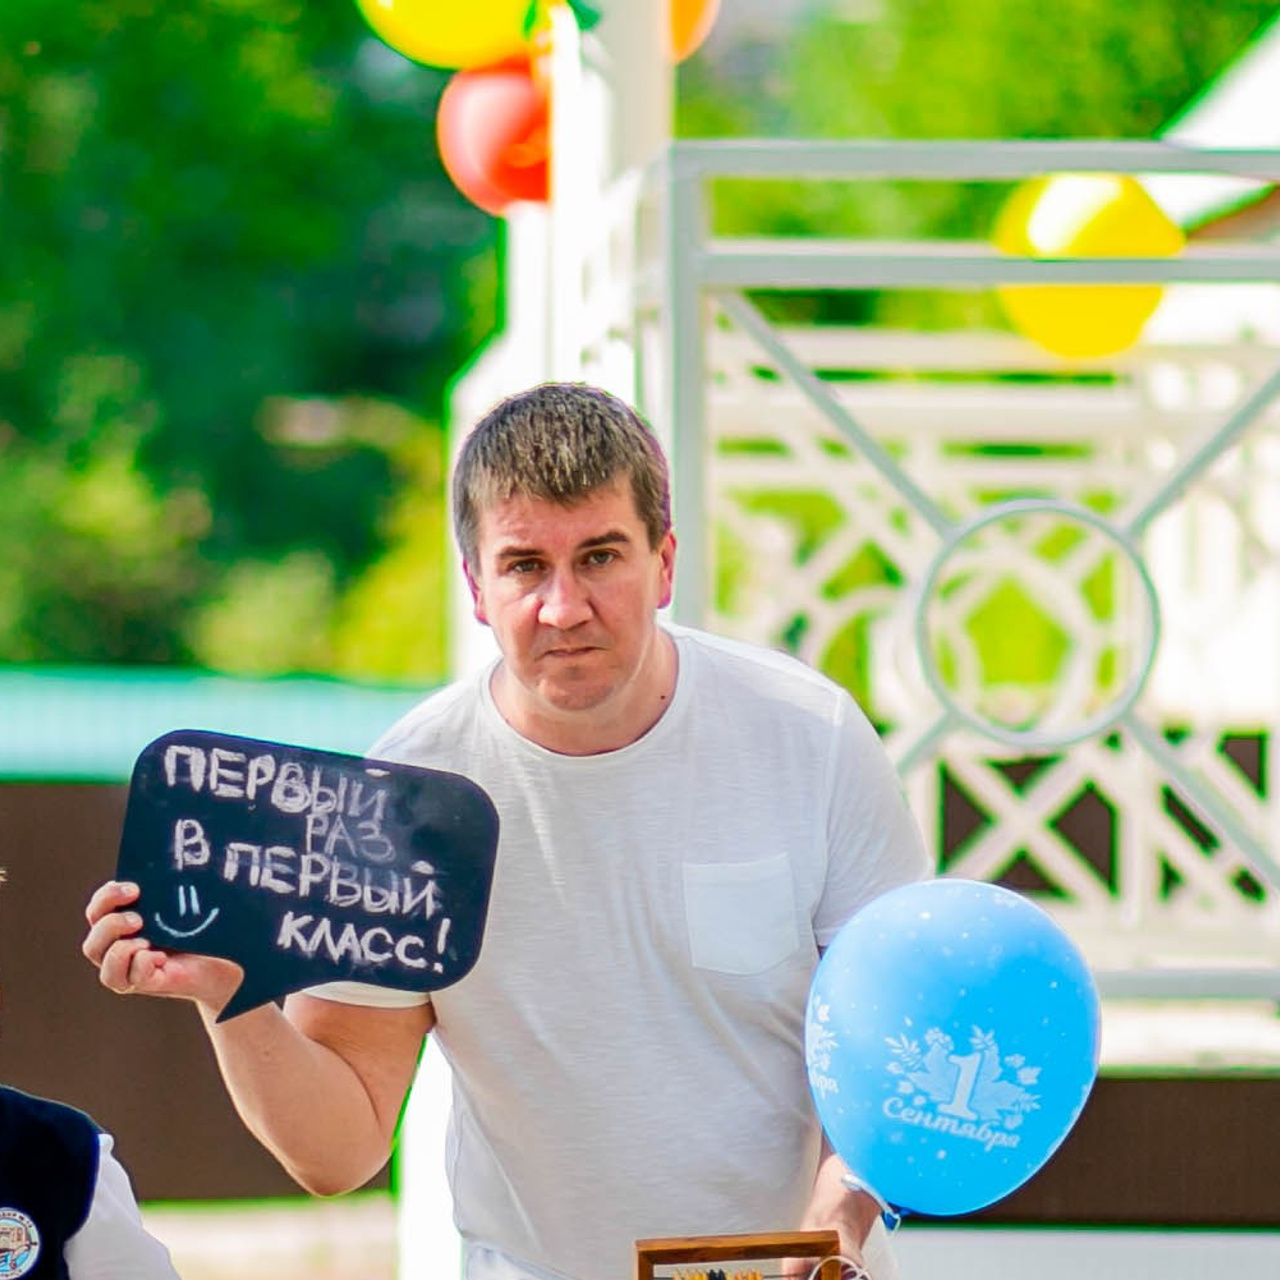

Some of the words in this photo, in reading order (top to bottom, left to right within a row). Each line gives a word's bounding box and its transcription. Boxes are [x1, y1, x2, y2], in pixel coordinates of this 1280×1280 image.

[165, 746, 389, 819] ПЕРВЫЙ
[176, 820, 210, 870] В
[224, 843, 437, 918] ПЕРВЫЙ
[306, 815, 396, 862] РАЗ
[277, 912, 451, 972] КЛАСС!
[939, 1053, 981, 1119] 1
[884, 1098, 1020, 1151] Сентября
